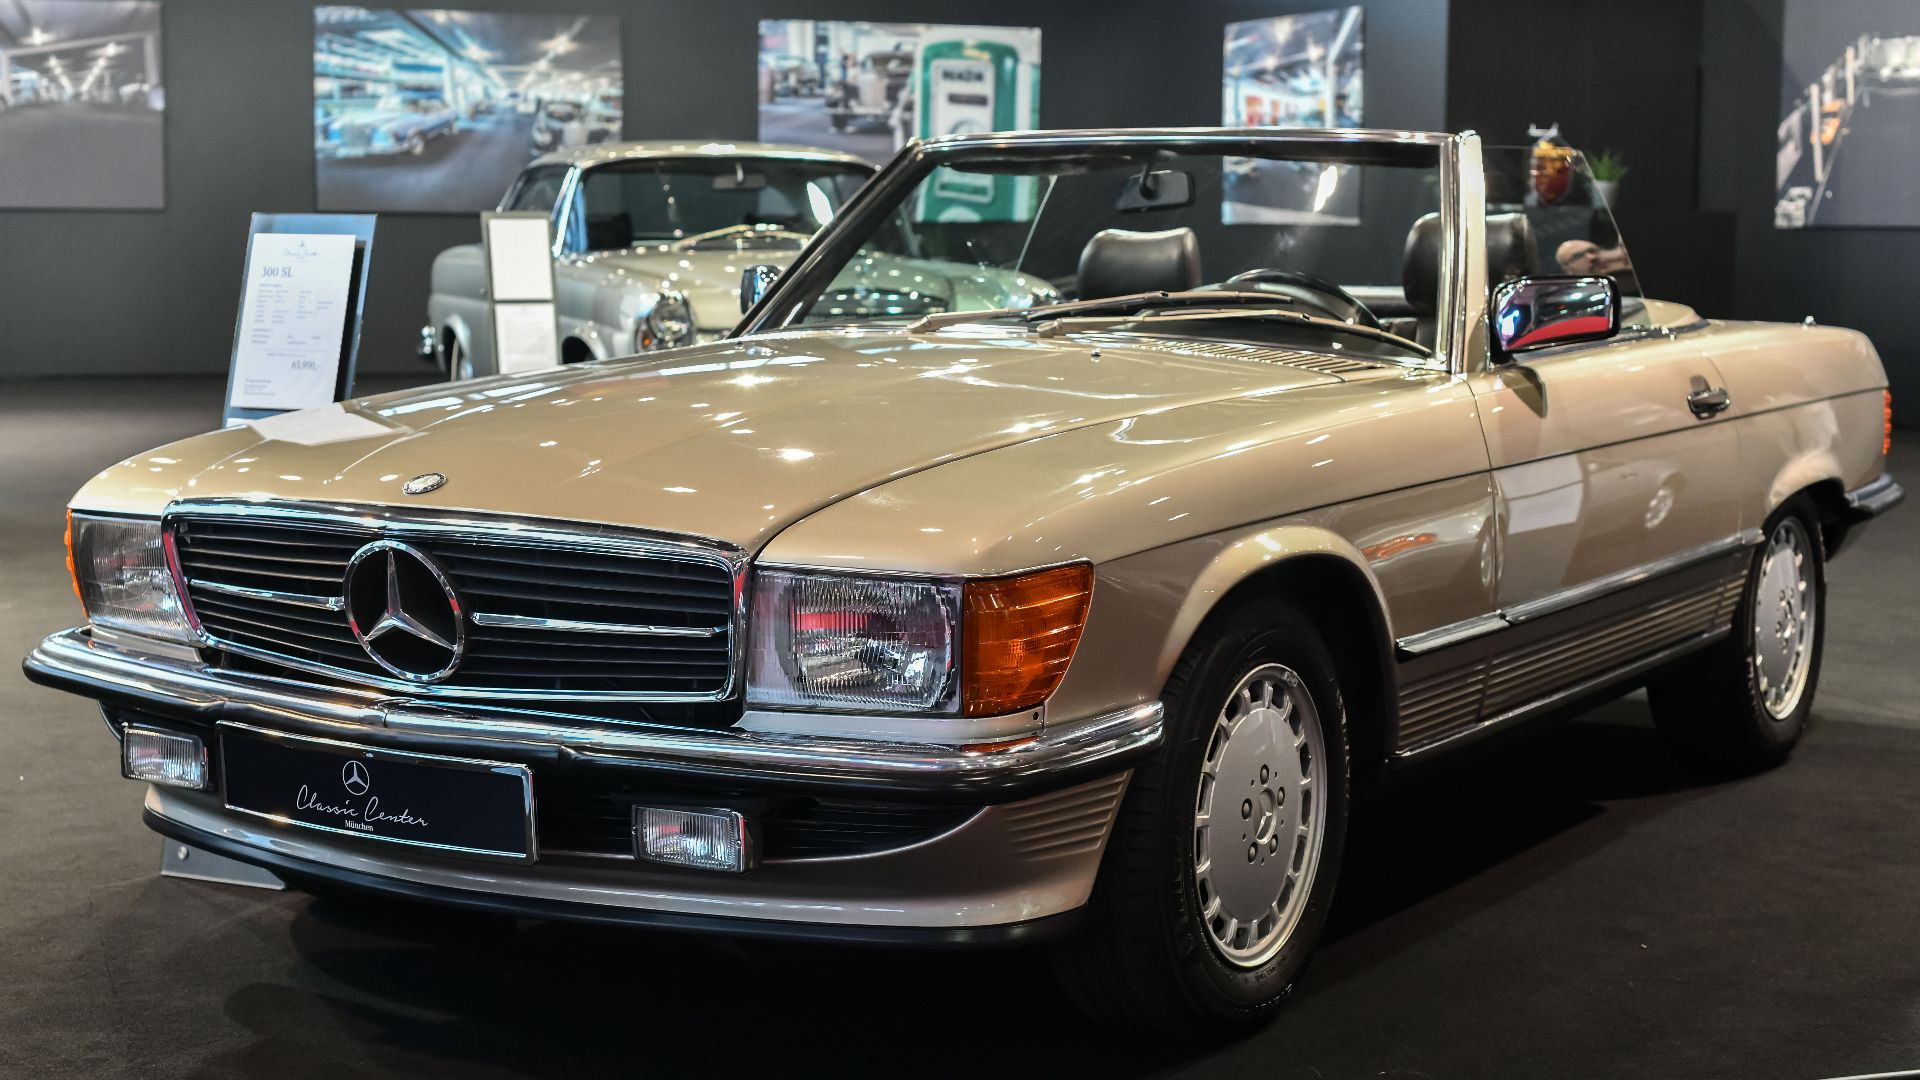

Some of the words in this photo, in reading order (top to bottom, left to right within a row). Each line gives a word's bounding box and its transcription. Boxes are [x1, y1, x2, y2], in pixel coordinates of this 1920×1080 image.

[261, 266, 279, 278] 300
[296, 784, 359, 816] Classic
[364, 796, 429, 827] Center
[344, 819, 374, 832] München
